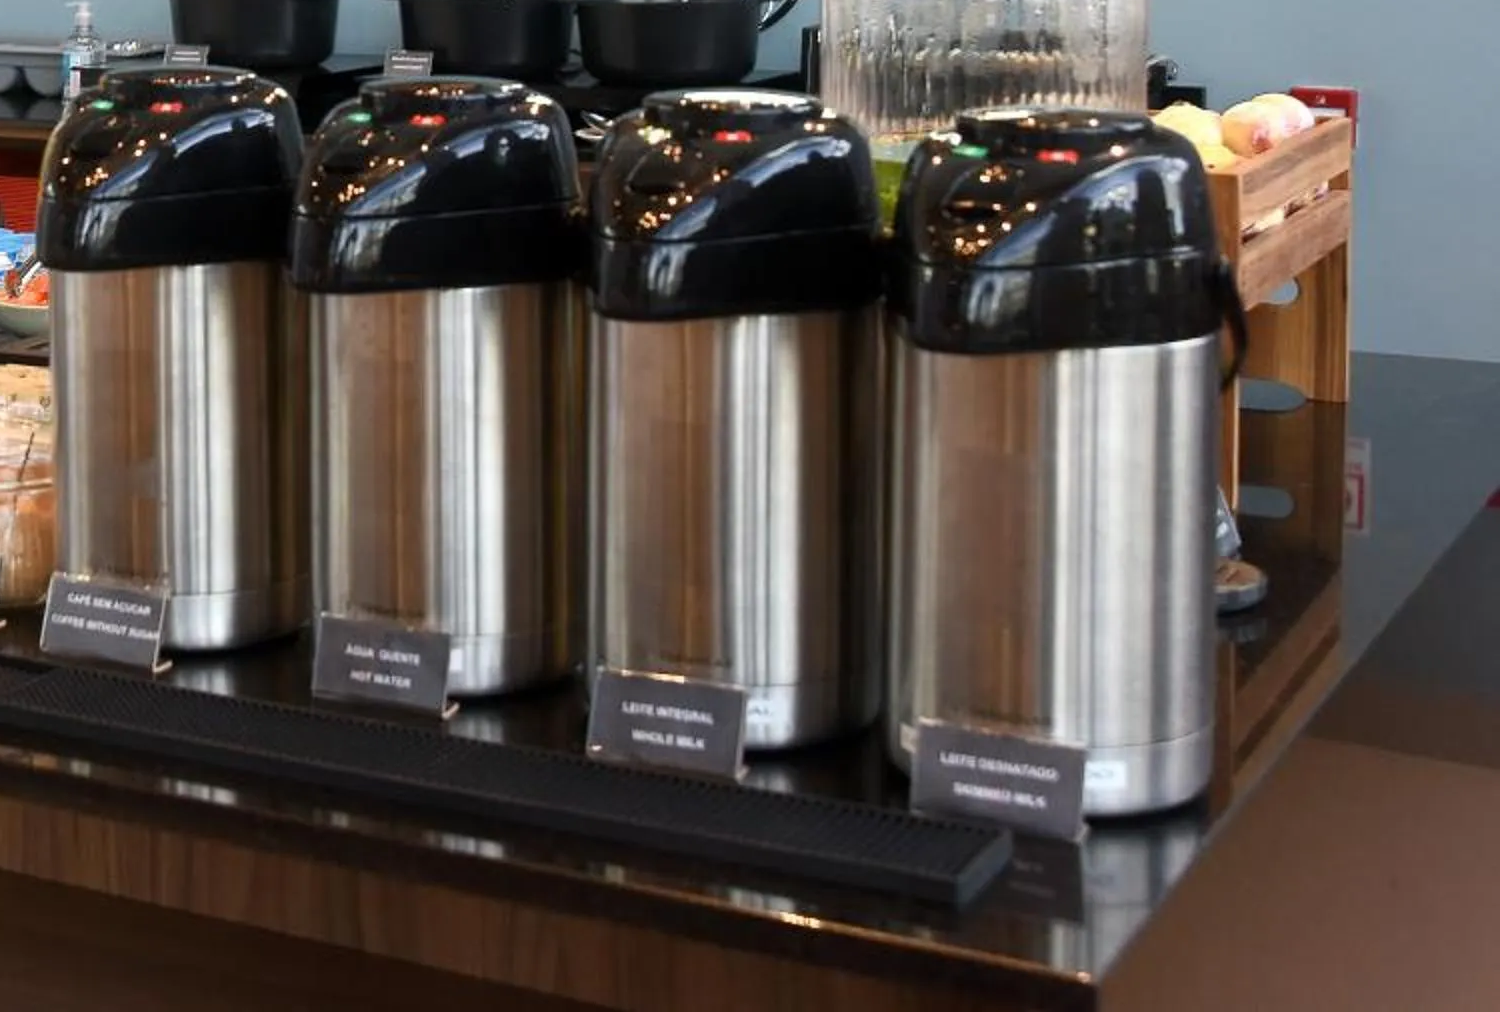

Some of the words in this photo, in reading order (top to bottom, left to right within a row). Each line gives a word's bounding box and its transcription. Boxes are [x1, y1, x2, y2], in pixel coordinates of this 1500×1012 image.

[621, 700, 655, 717] LEITE
[655, 704, 714, 726] INTEGRAL
[631, 728, 674, 747] WHOLE
[939, 750, 977, 770] LEITE
